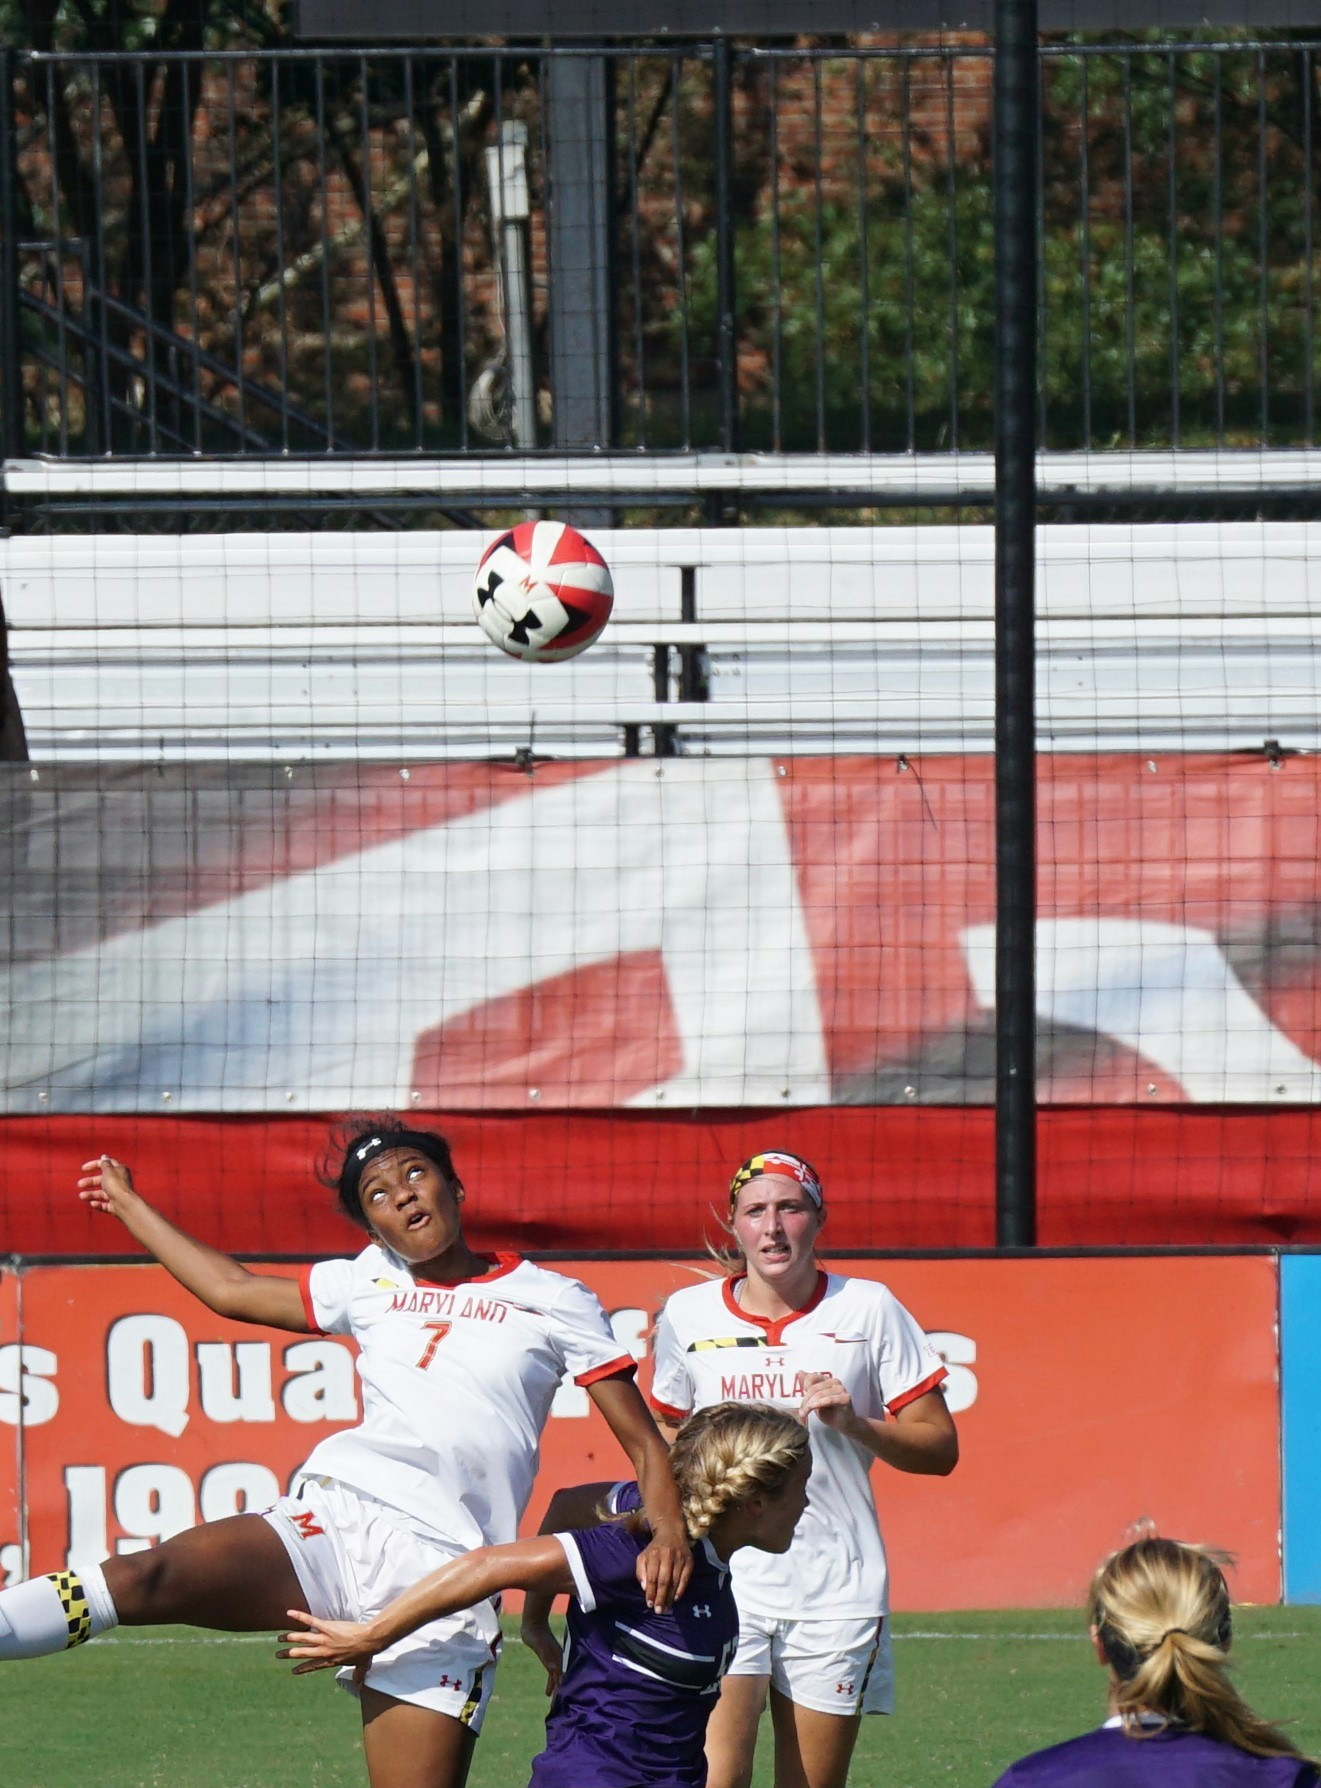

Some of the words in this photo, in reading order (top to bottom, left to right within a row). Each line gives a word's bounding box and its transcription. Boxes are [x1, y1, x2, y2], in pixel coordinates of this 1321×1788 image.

[416, 1320, 453, 1371] 7
[721, 1371, 833, 1401] MARYLA
[288, 1509, 325, 1540] M
